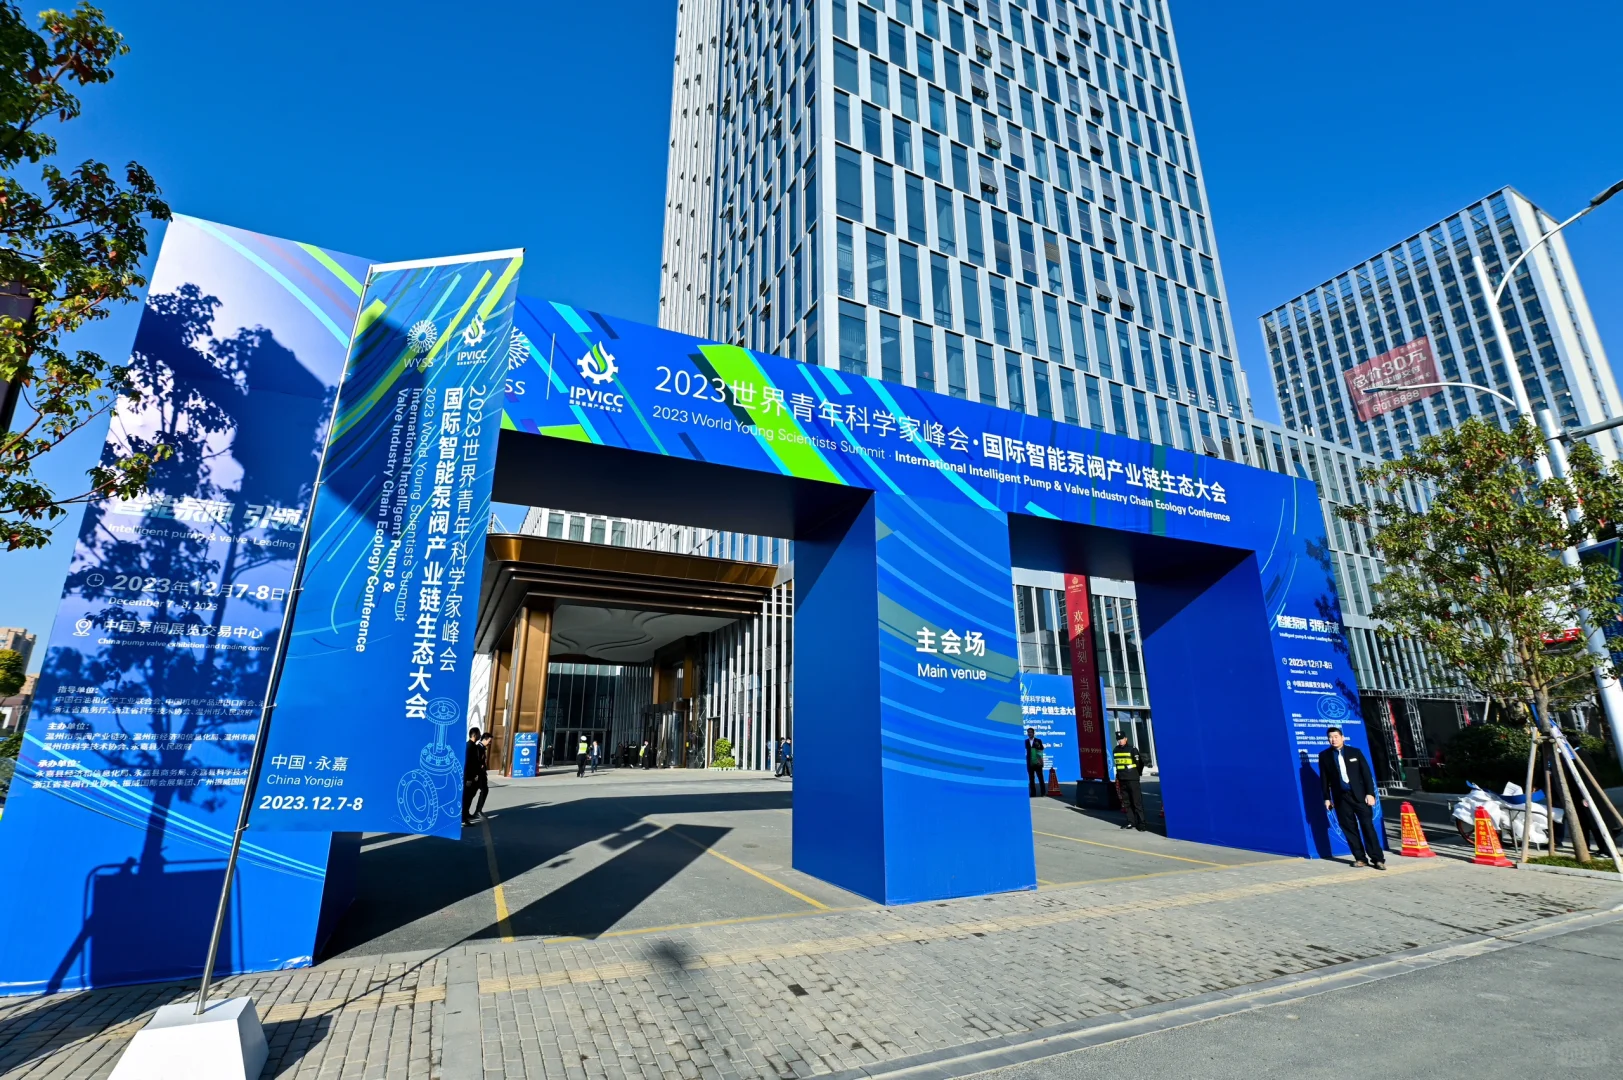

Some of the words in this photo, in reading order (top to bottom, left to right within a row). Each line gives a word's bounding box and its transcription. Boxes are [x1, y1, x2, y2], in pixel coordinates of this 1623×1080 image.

[403, 357, 434, 368] WYSS
[457, 349, 488, 361] IPVICC
[504, 378, 526, 395] SS
[569, 385, 624, 408] IPVICC
[393, 387, 409, 422] Valve
[423, 387, 436, 418] 2023
[402, 387, 423, 467] International
[417, 420, 433, 458] World
[383, 424, 404, 477] Industry
[652, 405, 689, 423] 2023
[691, 412, 732, 431] World
[734, 421, 775, 441] Young
[778, 428, 838, 451] Scientists
[840, 440, 886, 460] Summit
[894, 451, 967, 474] International
[968, 464, 1022, 485] Intelligent
[1023, 474, 1052, 491] Pump
[1053, 479, 1063, 491] &
[1064, 481, 1091, 497] Valve
[1091, 486, 1128, 504] Industry
[1129, 494, 1154, 508] Chain
[1154, 498, 1187, 516] Ecology
[1187, 504, 1231, 523] Conference
[410, 461, 427, 501] Young
[377, 480, 394, 517] Chain
[391, 470, 412, 536] Intelligent
[243, 503, 306, 532] 引领
[439, 384, 487, 673] 2023世界青年科学家峰会
[108, 523, 169, 538] Intelligent
[171, 530, 205, 543] pump
[207, 532, 217, 543] &
[219, 533, 248, 545] valve
[253, 536, 296, 550] Leading
[367, 520, 388, 572] Ecology
[402, 503, 422, 567] Scientists
[383, 539, 401, 578] Pump
[405, 387, 464, 720] 国际智能泵阀产业链生态大会
[111, 573, 285, 602] 2023年12月7-8日
[382, 581, 395, 593] &
[394, 570, 412, 622] Summit
[108, 596, 165, 608] December
[166, 599, 174, 609] 7
[194, 602, 219, 612] 2023
[355, 575, 379, 653] Conference
[97, 637, 121, 645] China
[121, 639, 145, 648] pump
[146, 640, 167, 648] valve
[167, 641, 205, 649] exhibition
[205, 642, 220, 650] and
[220, 643, 247, 652] trading
[247, 644, 271, 652] center
[103, 619, 263, 640] 中国泵阀展览交易中心
[915, 625, 986, 657] 主会场
[917, 662, 948, 679] Main
[950, 667, 987, 681] venue
[270, 753, 350, 772] 中国·永嘉
[266, 773, 301, 785] China
[303, 775, 344, 788] Yongjia
[258, 795, 364, 812] 2023.12.7-8
